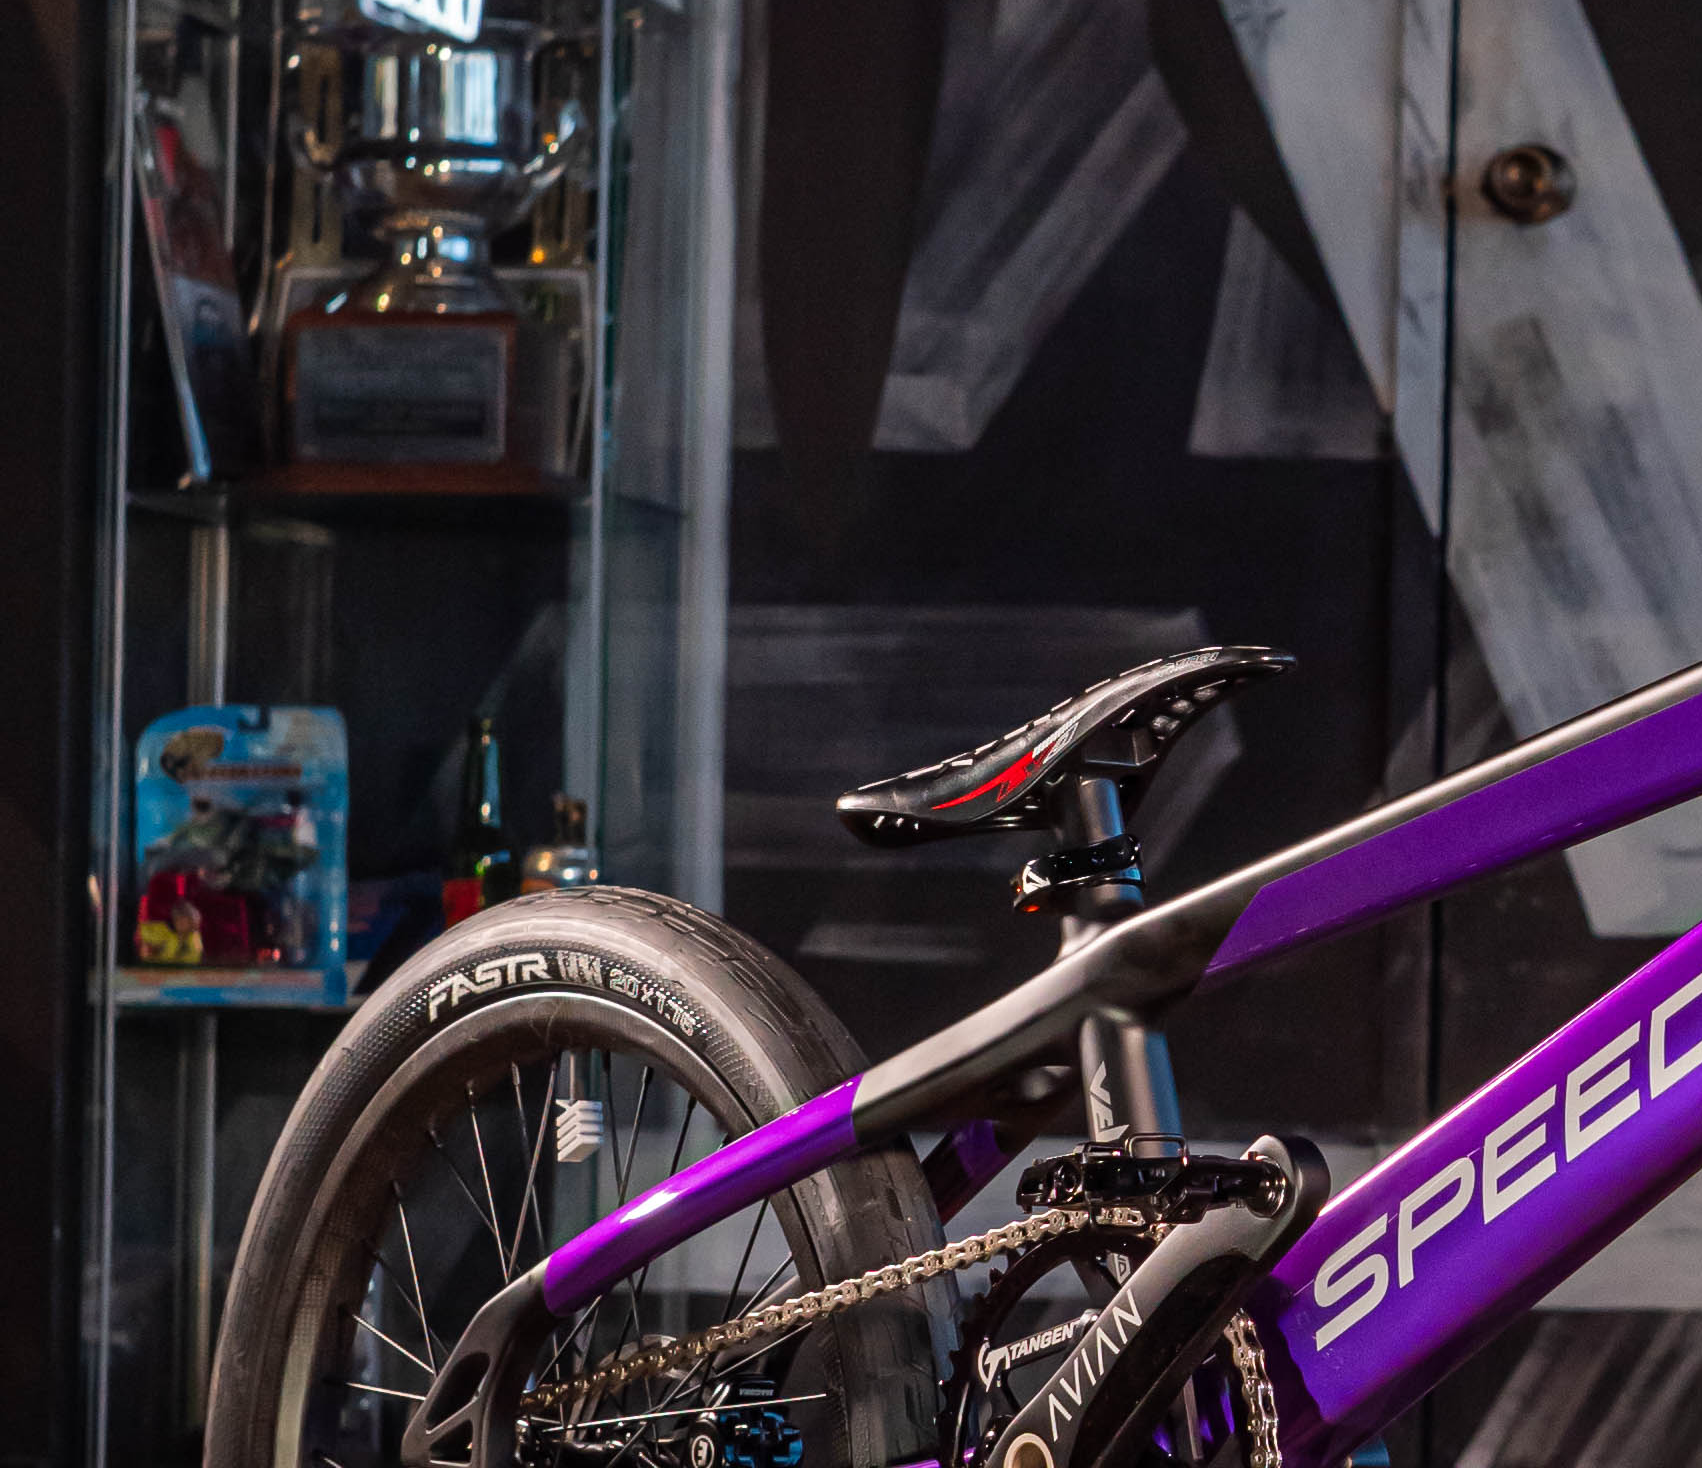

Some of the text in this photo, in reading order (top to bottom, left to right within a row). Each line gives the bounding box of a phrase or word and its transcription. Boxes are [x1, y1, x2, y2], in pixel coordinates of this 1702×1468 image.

[428, 952, 551, 1024] FASTR
[1009, 1319, 1081, 1361] TANGEN
[1046, 1288, 1143, 1443] AVIAN
